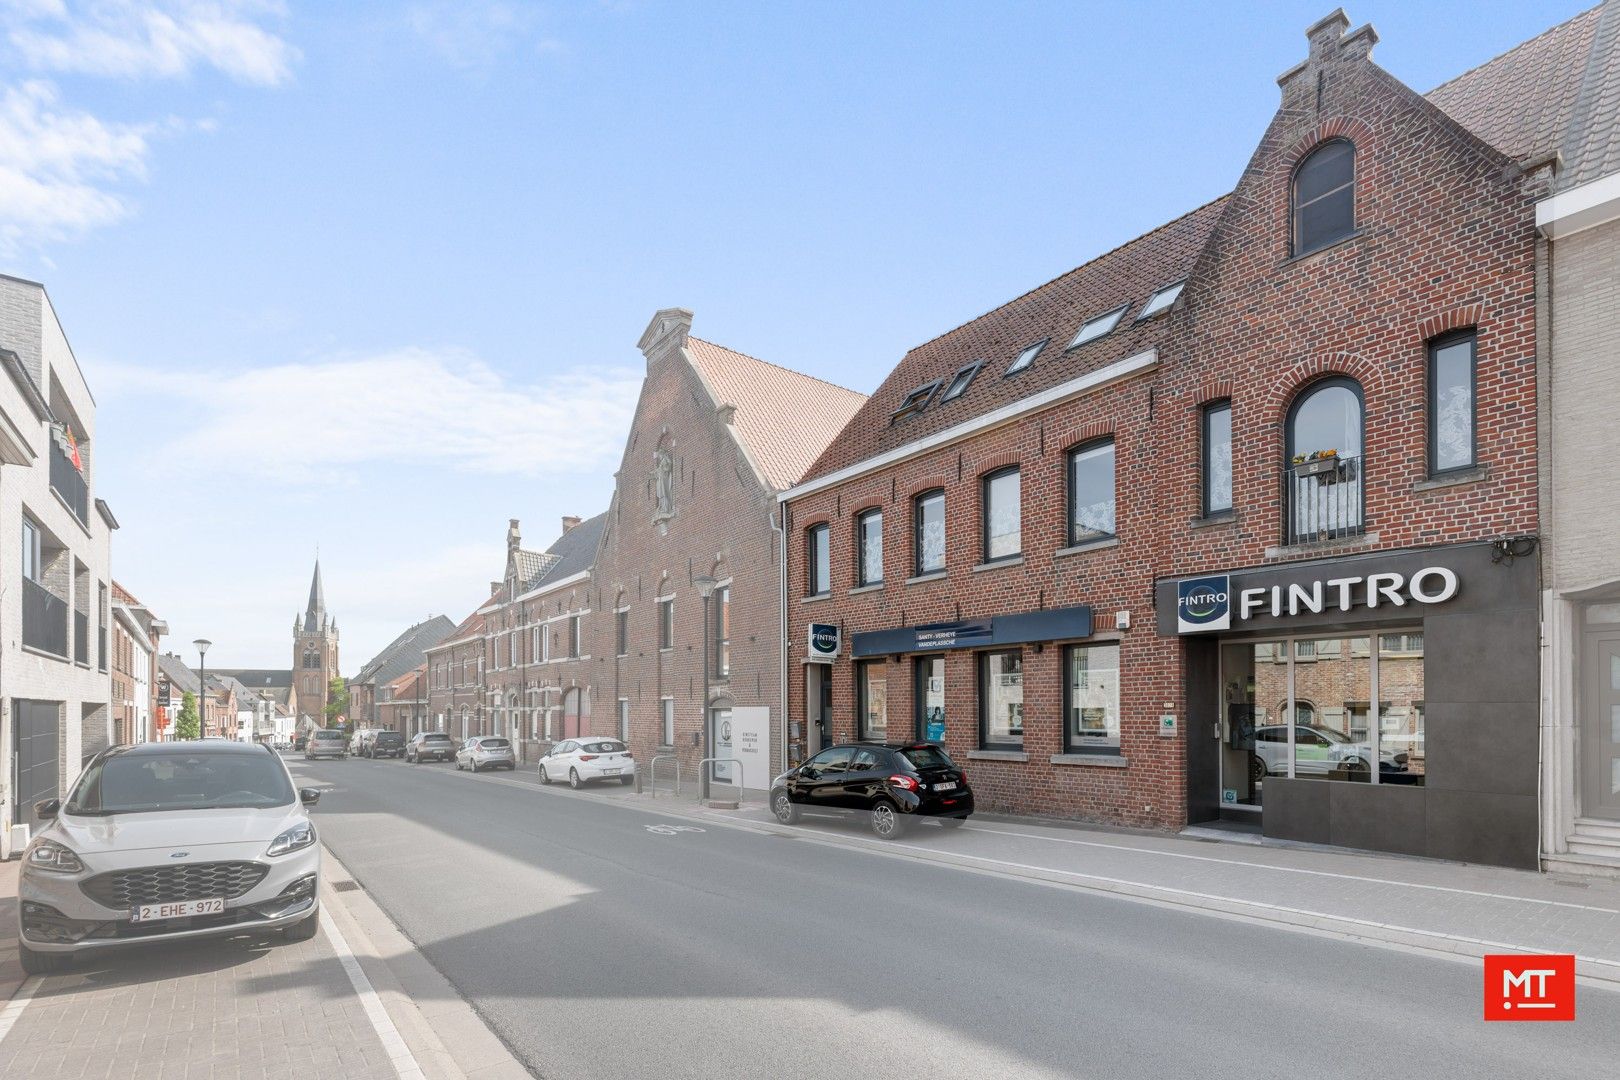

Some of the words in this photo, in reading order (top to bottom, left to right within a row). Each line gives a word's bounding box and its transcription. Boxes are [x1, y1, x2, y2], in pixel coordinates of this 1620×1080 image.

[1178, 592, 1227, 607] FINTRO
[1240, 566, 1458, 620] FINTRO
[812, 633, 837, 642] FINTRO
